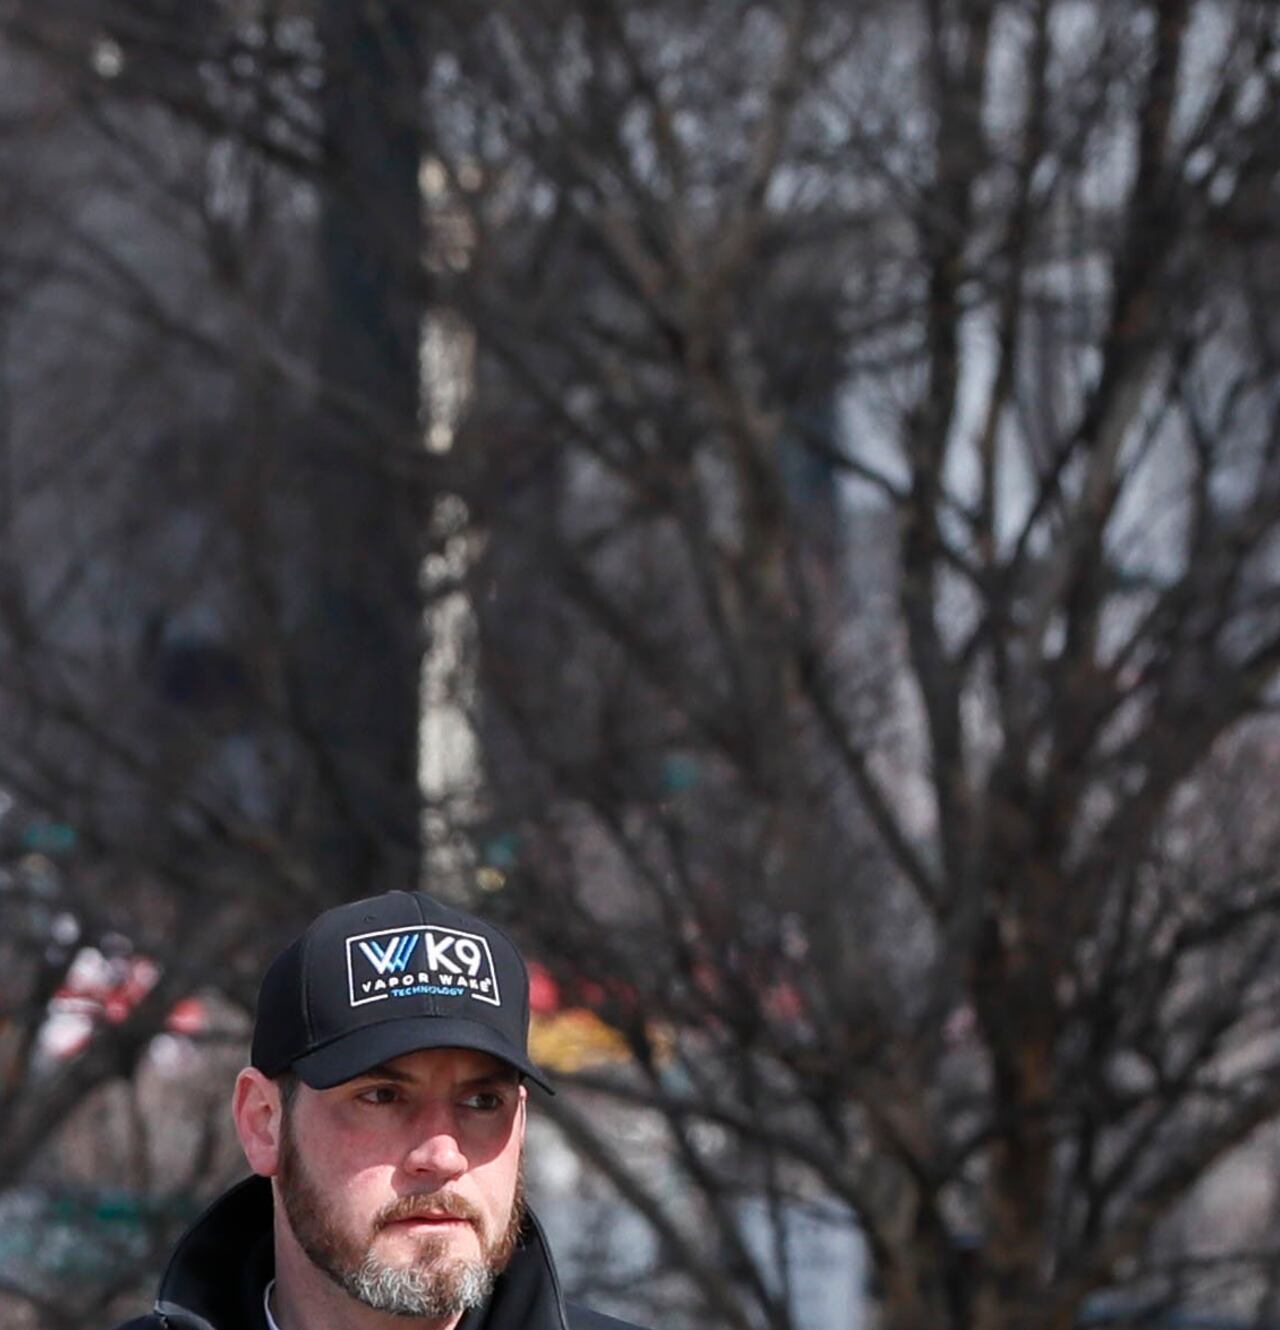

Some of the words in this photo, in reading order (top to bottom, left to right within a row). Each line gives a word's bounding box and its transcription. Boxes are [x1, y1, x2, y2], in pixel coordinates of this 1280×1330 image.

[424, 932, 482, 977] K9
[361, 972, 429, 993] VAPOR
[390, 984, 465, 998] TECHNOLOGY
